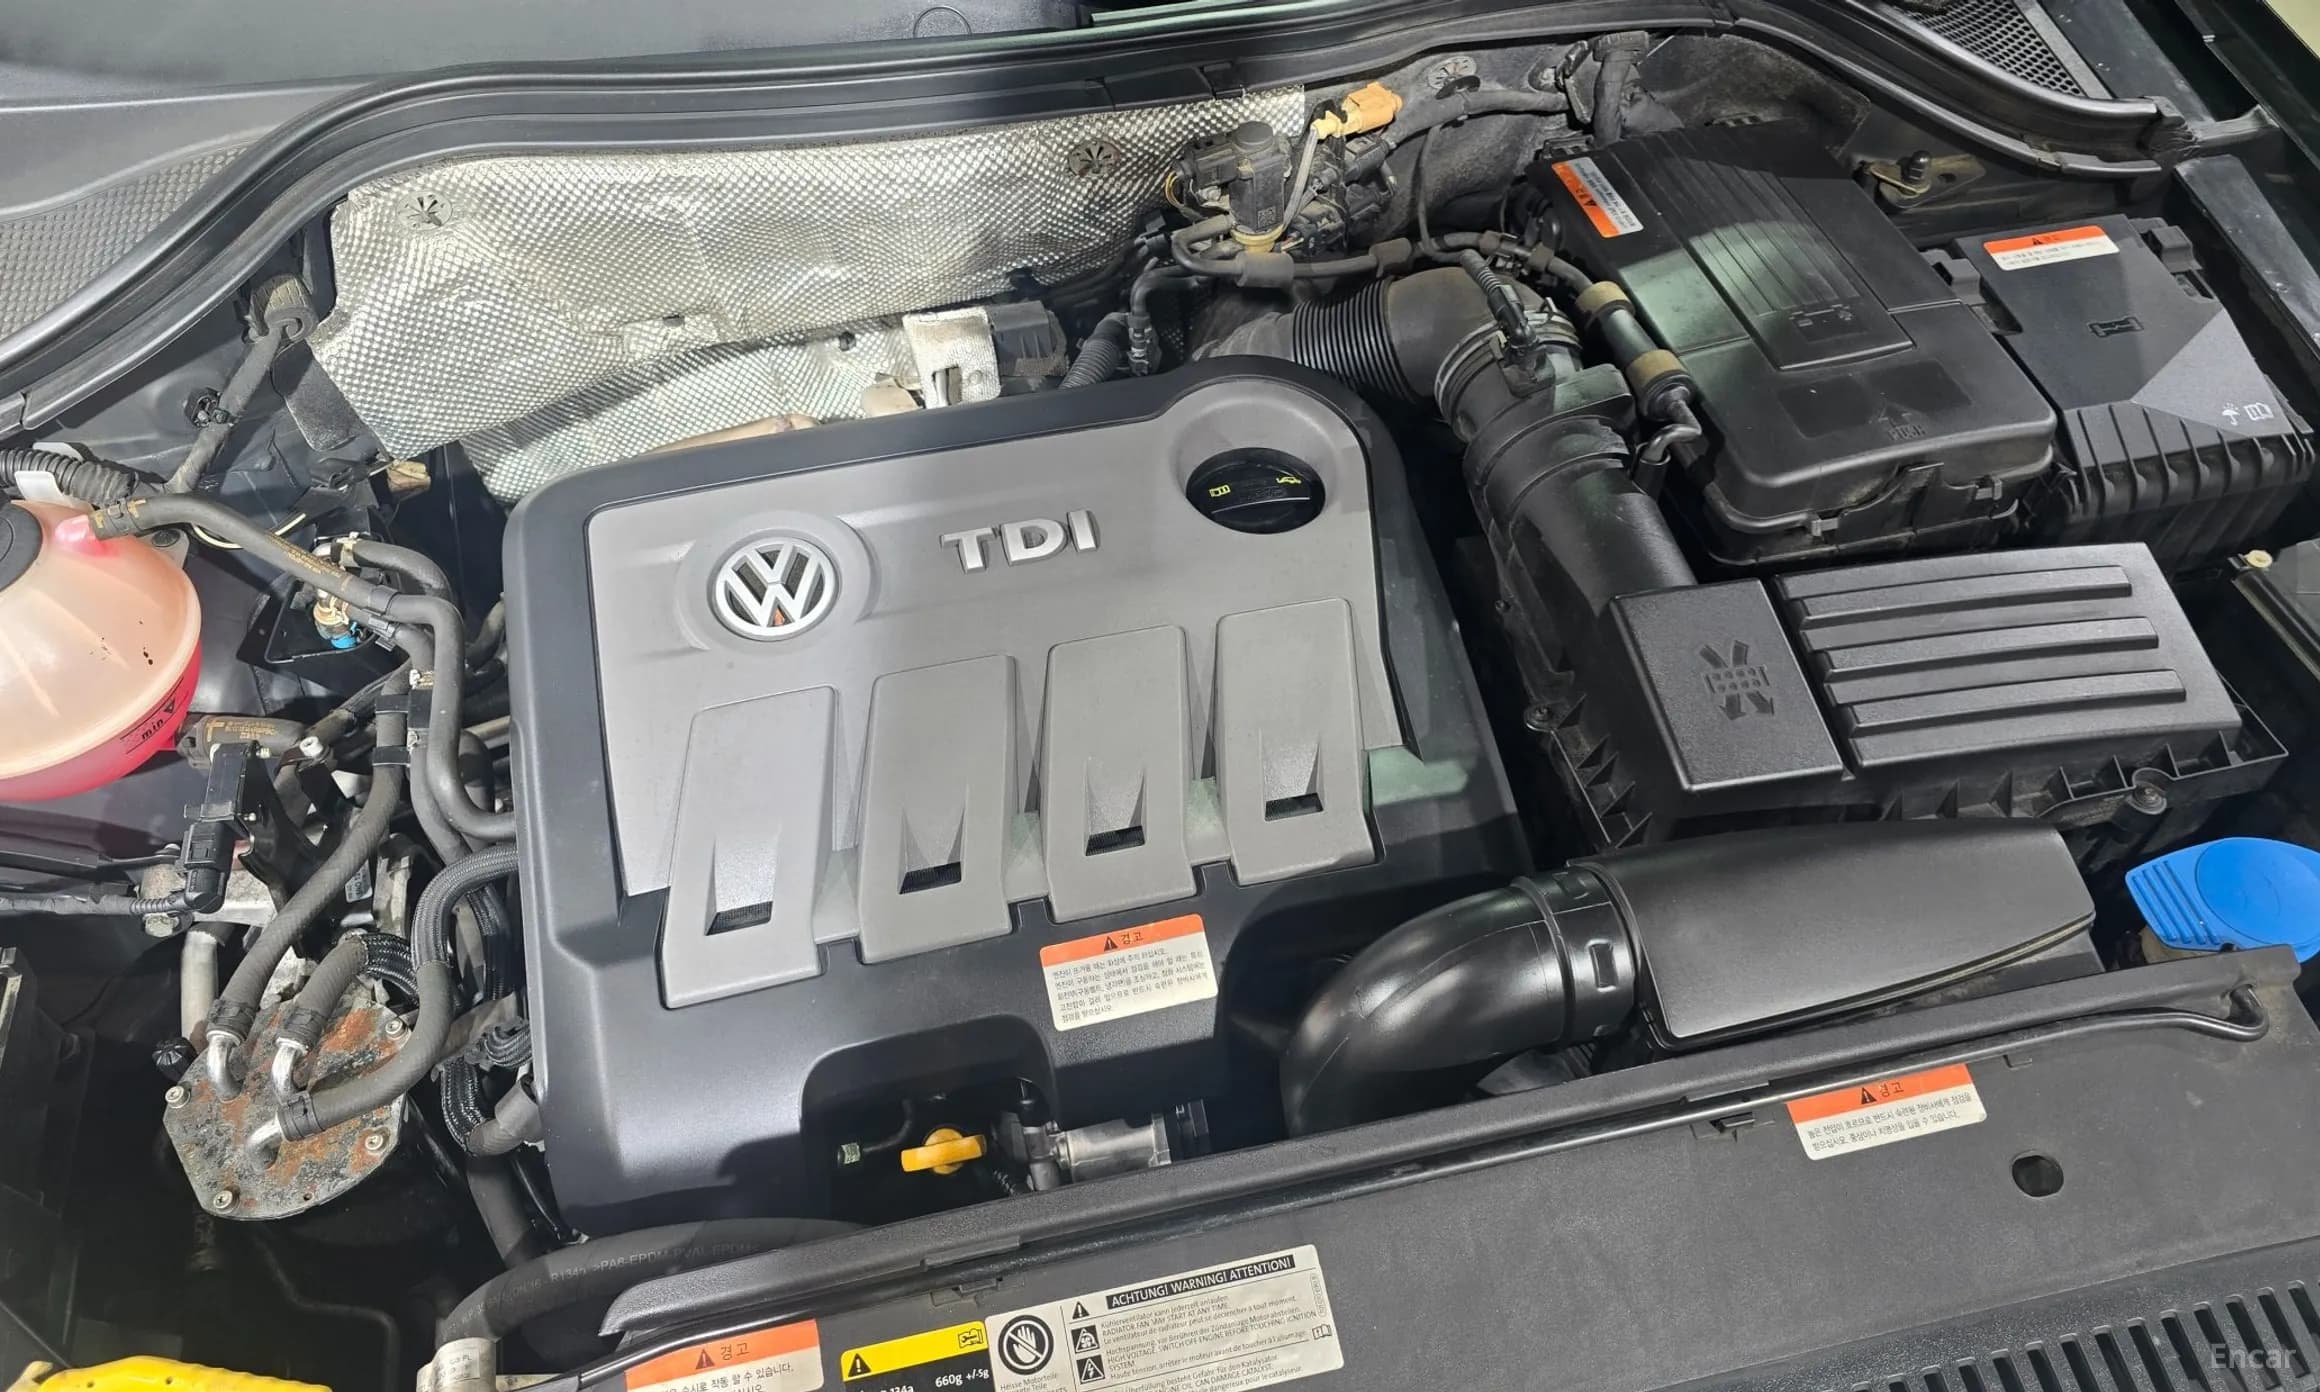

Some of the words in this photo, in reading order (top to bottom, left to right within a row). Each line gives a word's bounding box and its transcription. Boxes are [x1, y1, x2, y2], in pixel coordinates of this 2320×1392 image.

[941, 510, 1100, 574] TDI
[715, 537, 837, 637] VW
[141, 718, 164, 741] min
[1111, 1285, 1169, 1307] ACHTUNG!
[1171, 1272, 1228, 1294] WARNING!
[1229, 1258, 1292, 1281] ATTENTION!
[720, 1342, 749, 1361] 경고
[935, 1374, 963, 1388] 660g
